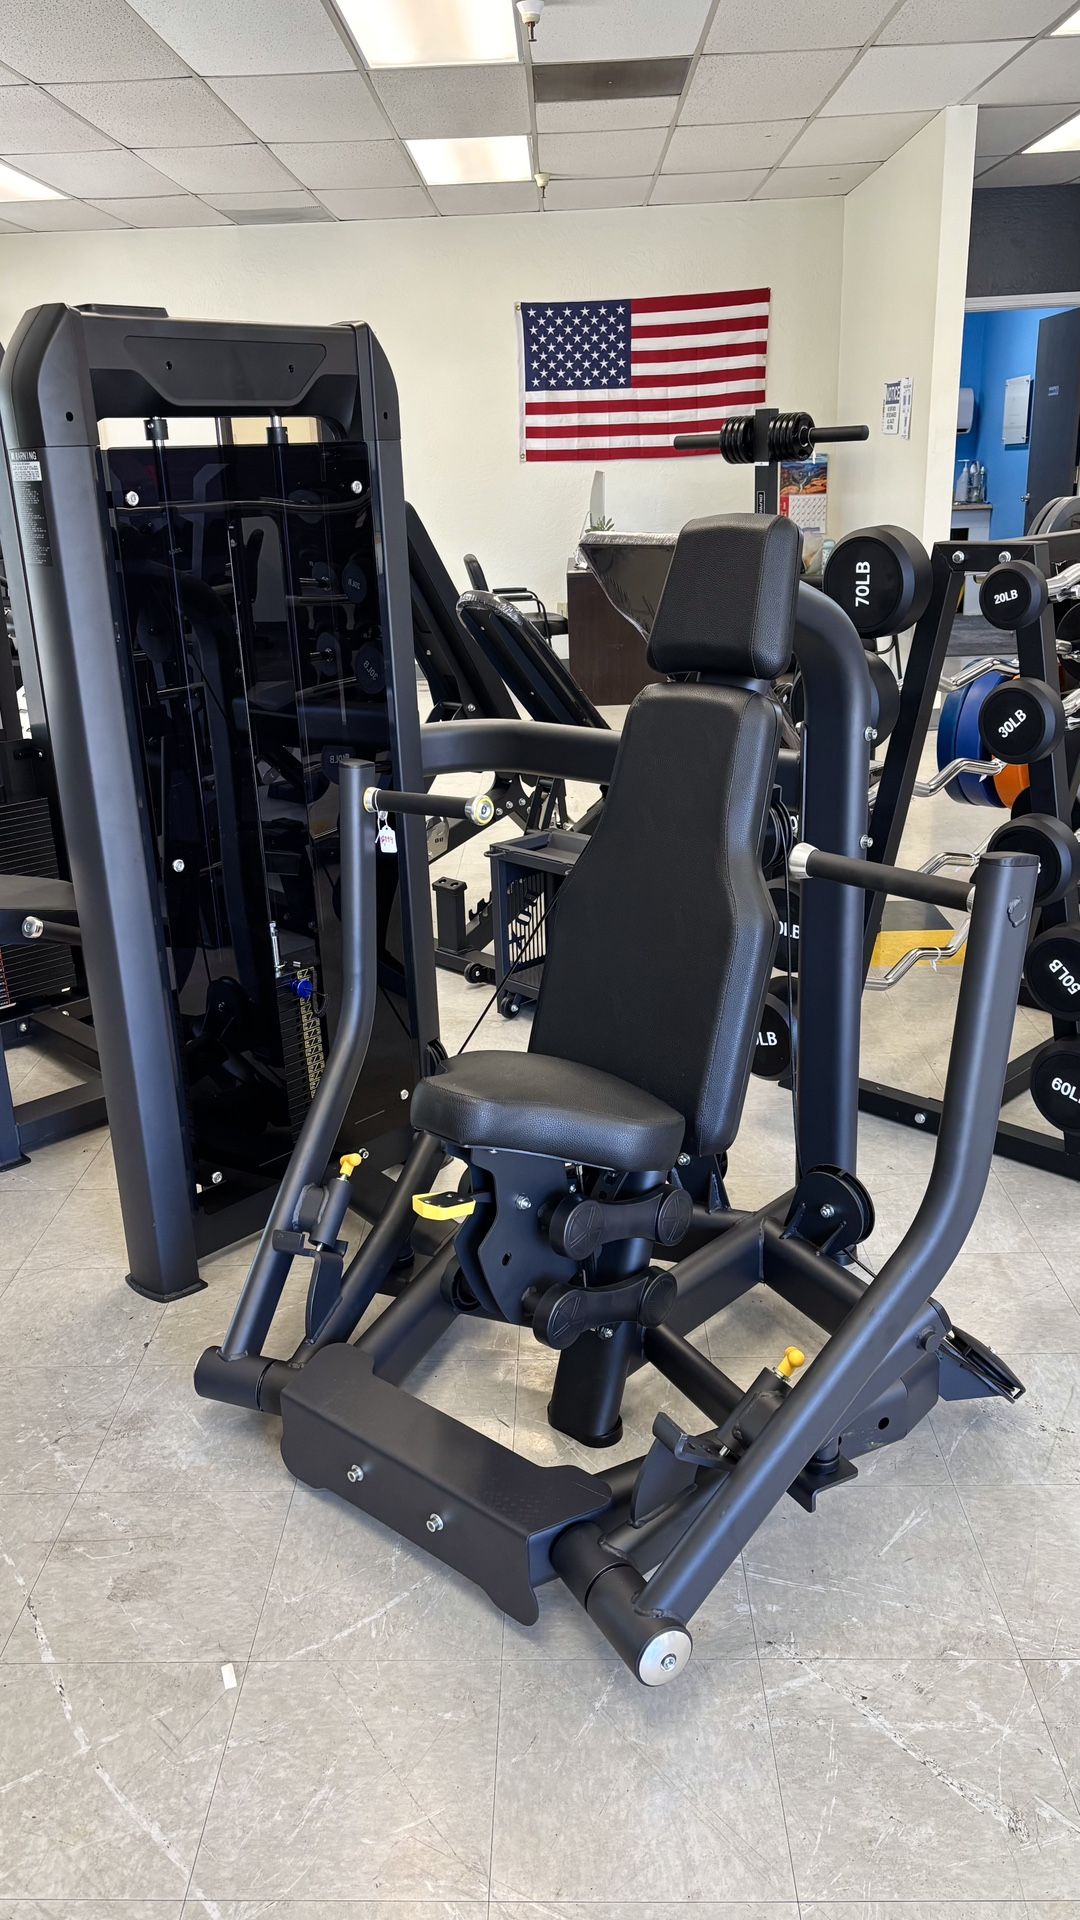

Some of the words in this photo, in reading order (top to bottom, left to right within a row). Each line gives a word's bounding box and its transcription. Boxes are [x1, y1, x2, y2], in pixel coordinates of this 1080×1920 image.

[855, 561, 871, 607] 70LB
[993, 589, 1019, 605] 20LB
[998, 709, 1028, 739] 30LB
[1048, 959, 1080, 995] 50LB
[1051, 1077, 1080, 1104] 60L
